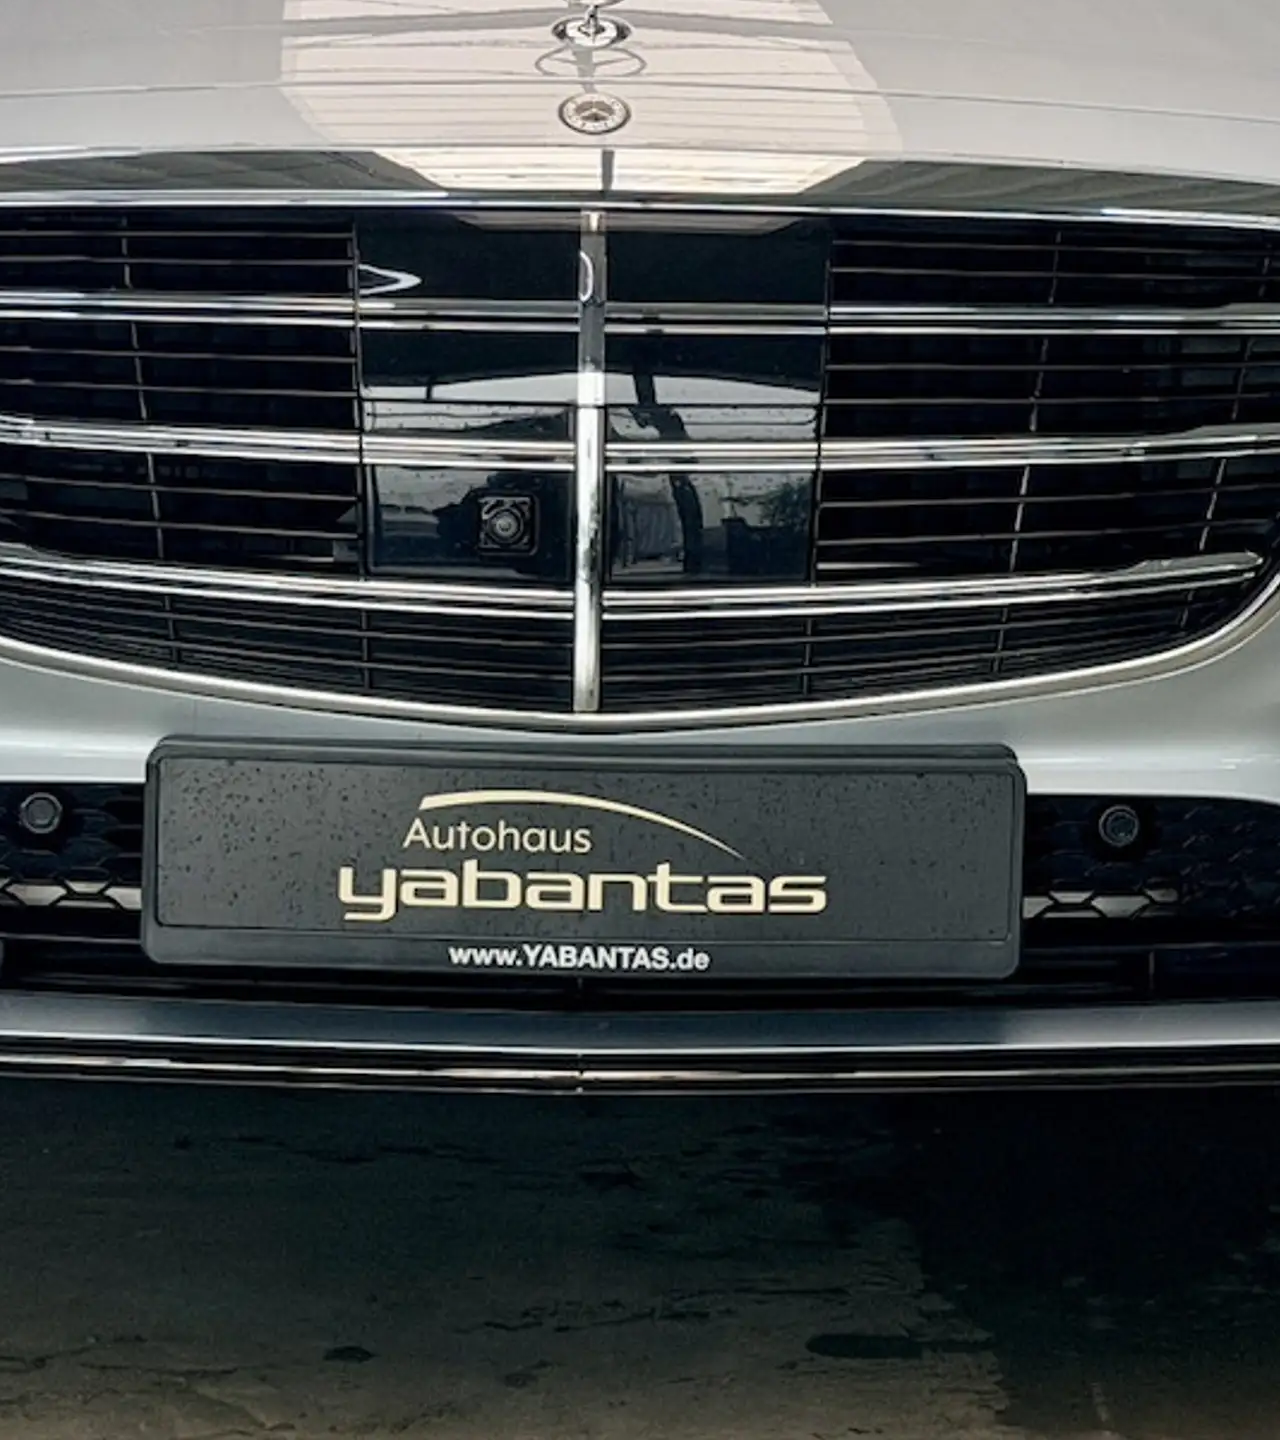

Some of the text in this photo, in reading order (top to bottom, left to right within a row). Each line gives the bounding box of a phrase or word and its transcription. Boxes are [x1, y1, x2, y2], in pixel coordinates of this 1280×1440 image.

[402, 817, 593, 854] Autohaus
[338, 858, 827, 922] yabantas
[449, 944, 711, 971] www.YABANTAS.de
